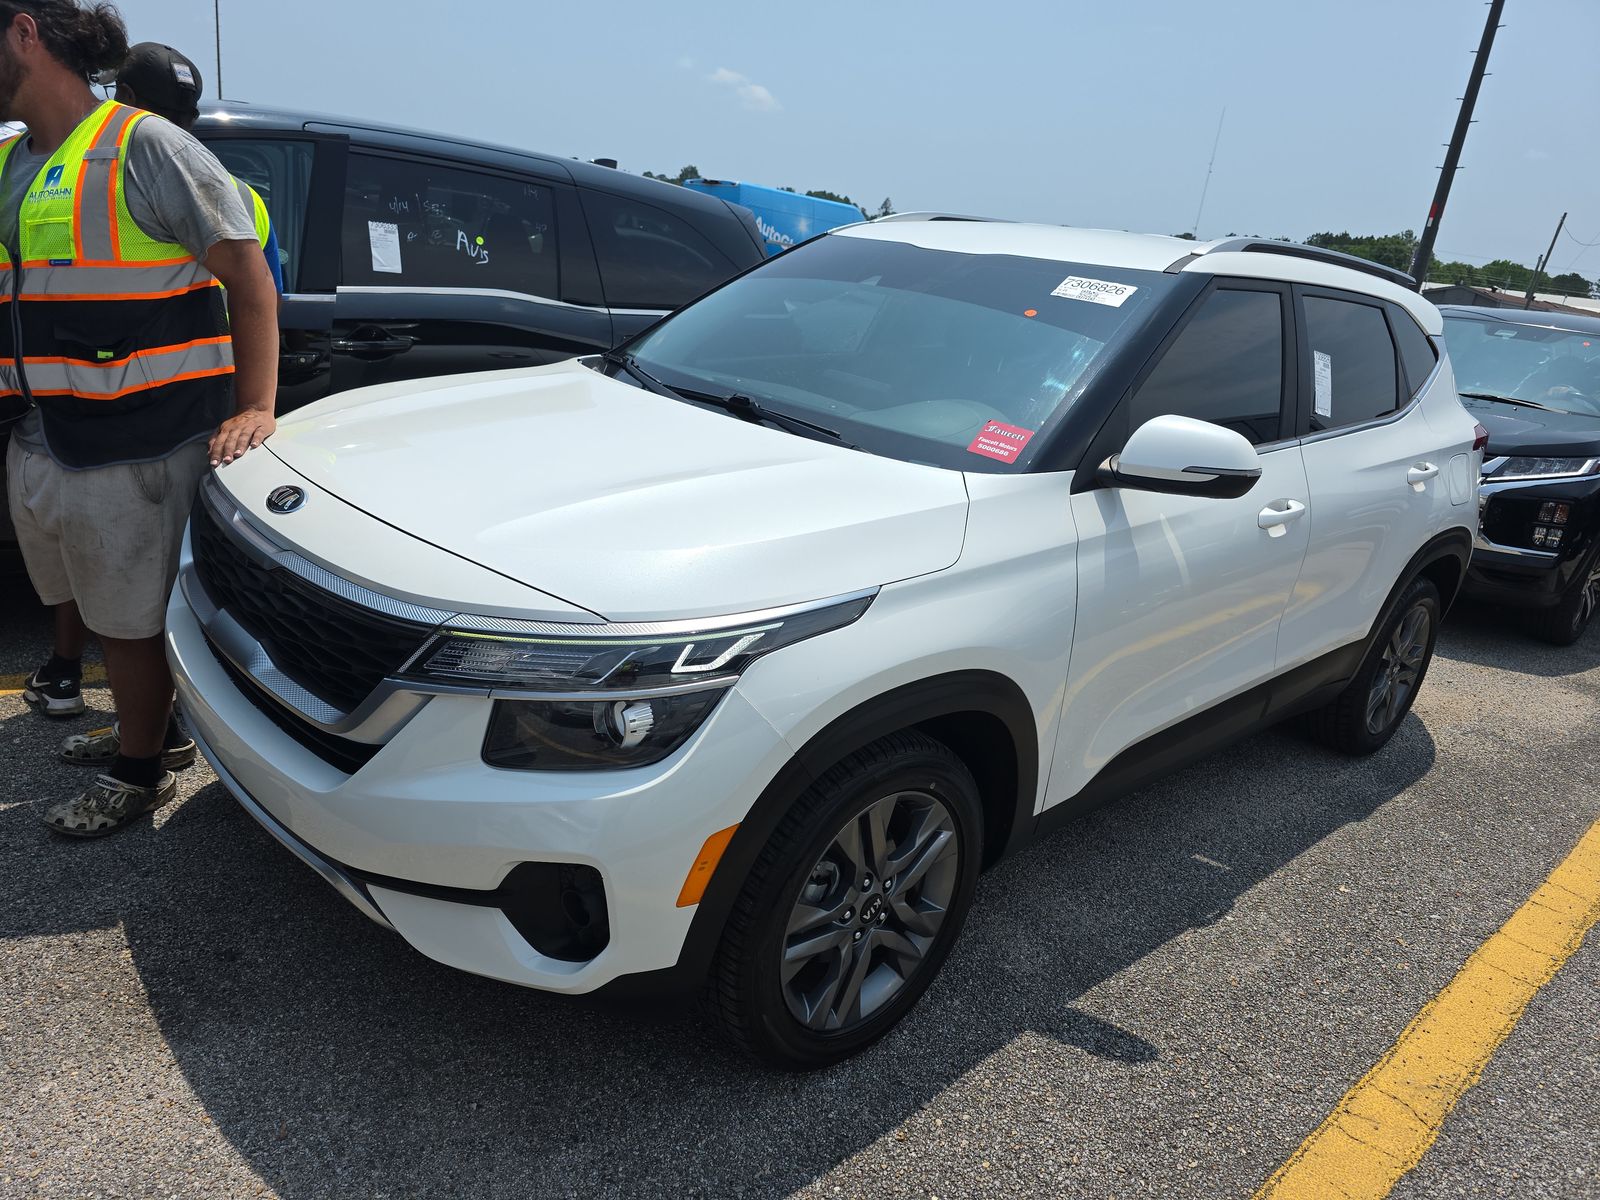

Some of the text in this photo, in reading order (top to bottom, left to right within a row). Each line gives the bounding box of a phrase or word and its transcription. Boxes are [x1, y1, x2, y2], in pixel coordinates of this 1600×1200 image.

[29, 188, 72, 199] AUTOBAHN
[1063, 278, 1127, 295] 7306826
[985, 425, 1025, 441] Faucett
[862, 898, 882, 920] KIA
